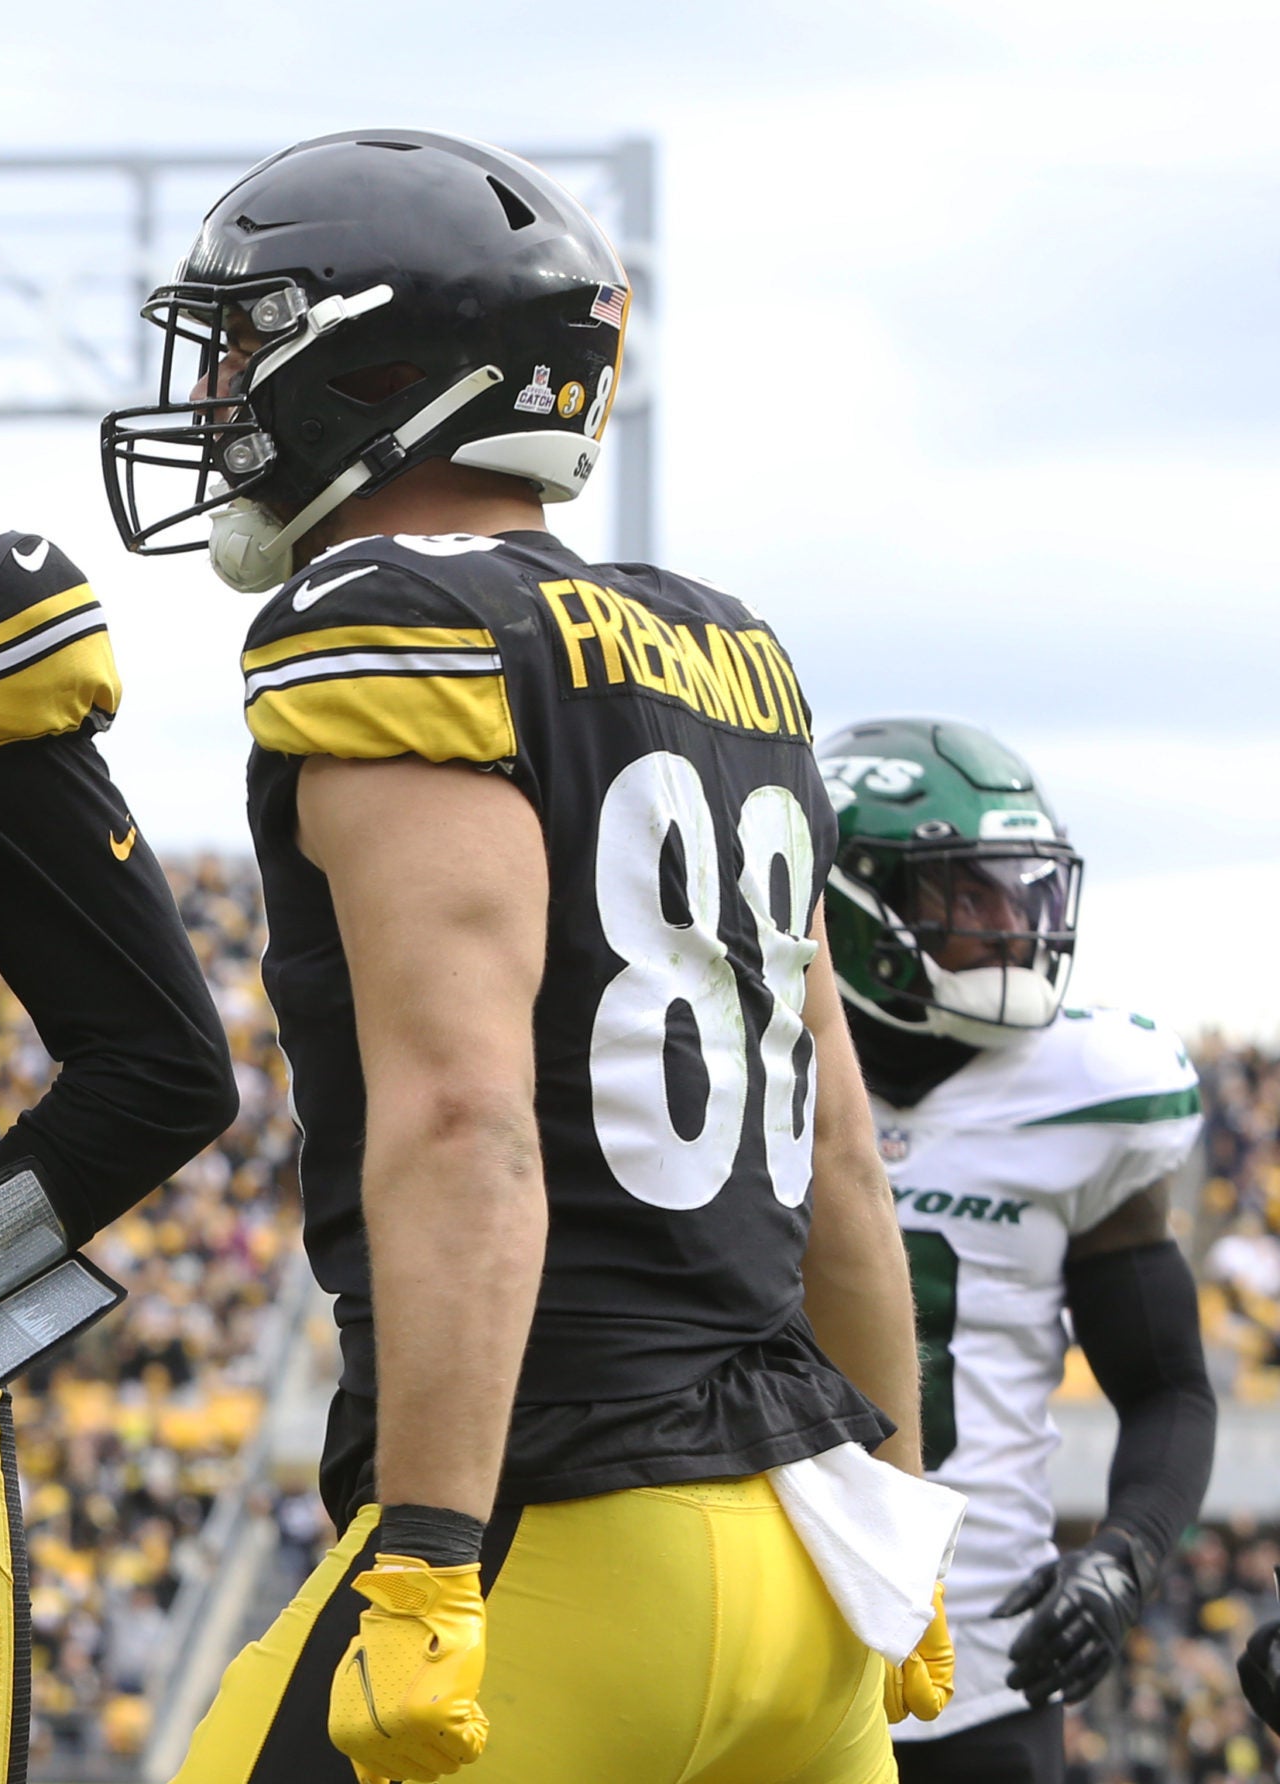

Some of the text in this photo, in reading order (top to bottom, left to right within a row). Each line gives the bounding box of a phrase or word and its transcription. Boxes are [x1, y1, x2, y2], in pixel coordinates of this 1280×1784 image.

[519, 392, 553, 407] CATCH
[563, 385, 579, 414] 3
[589, 750, 818, 1211] 88
